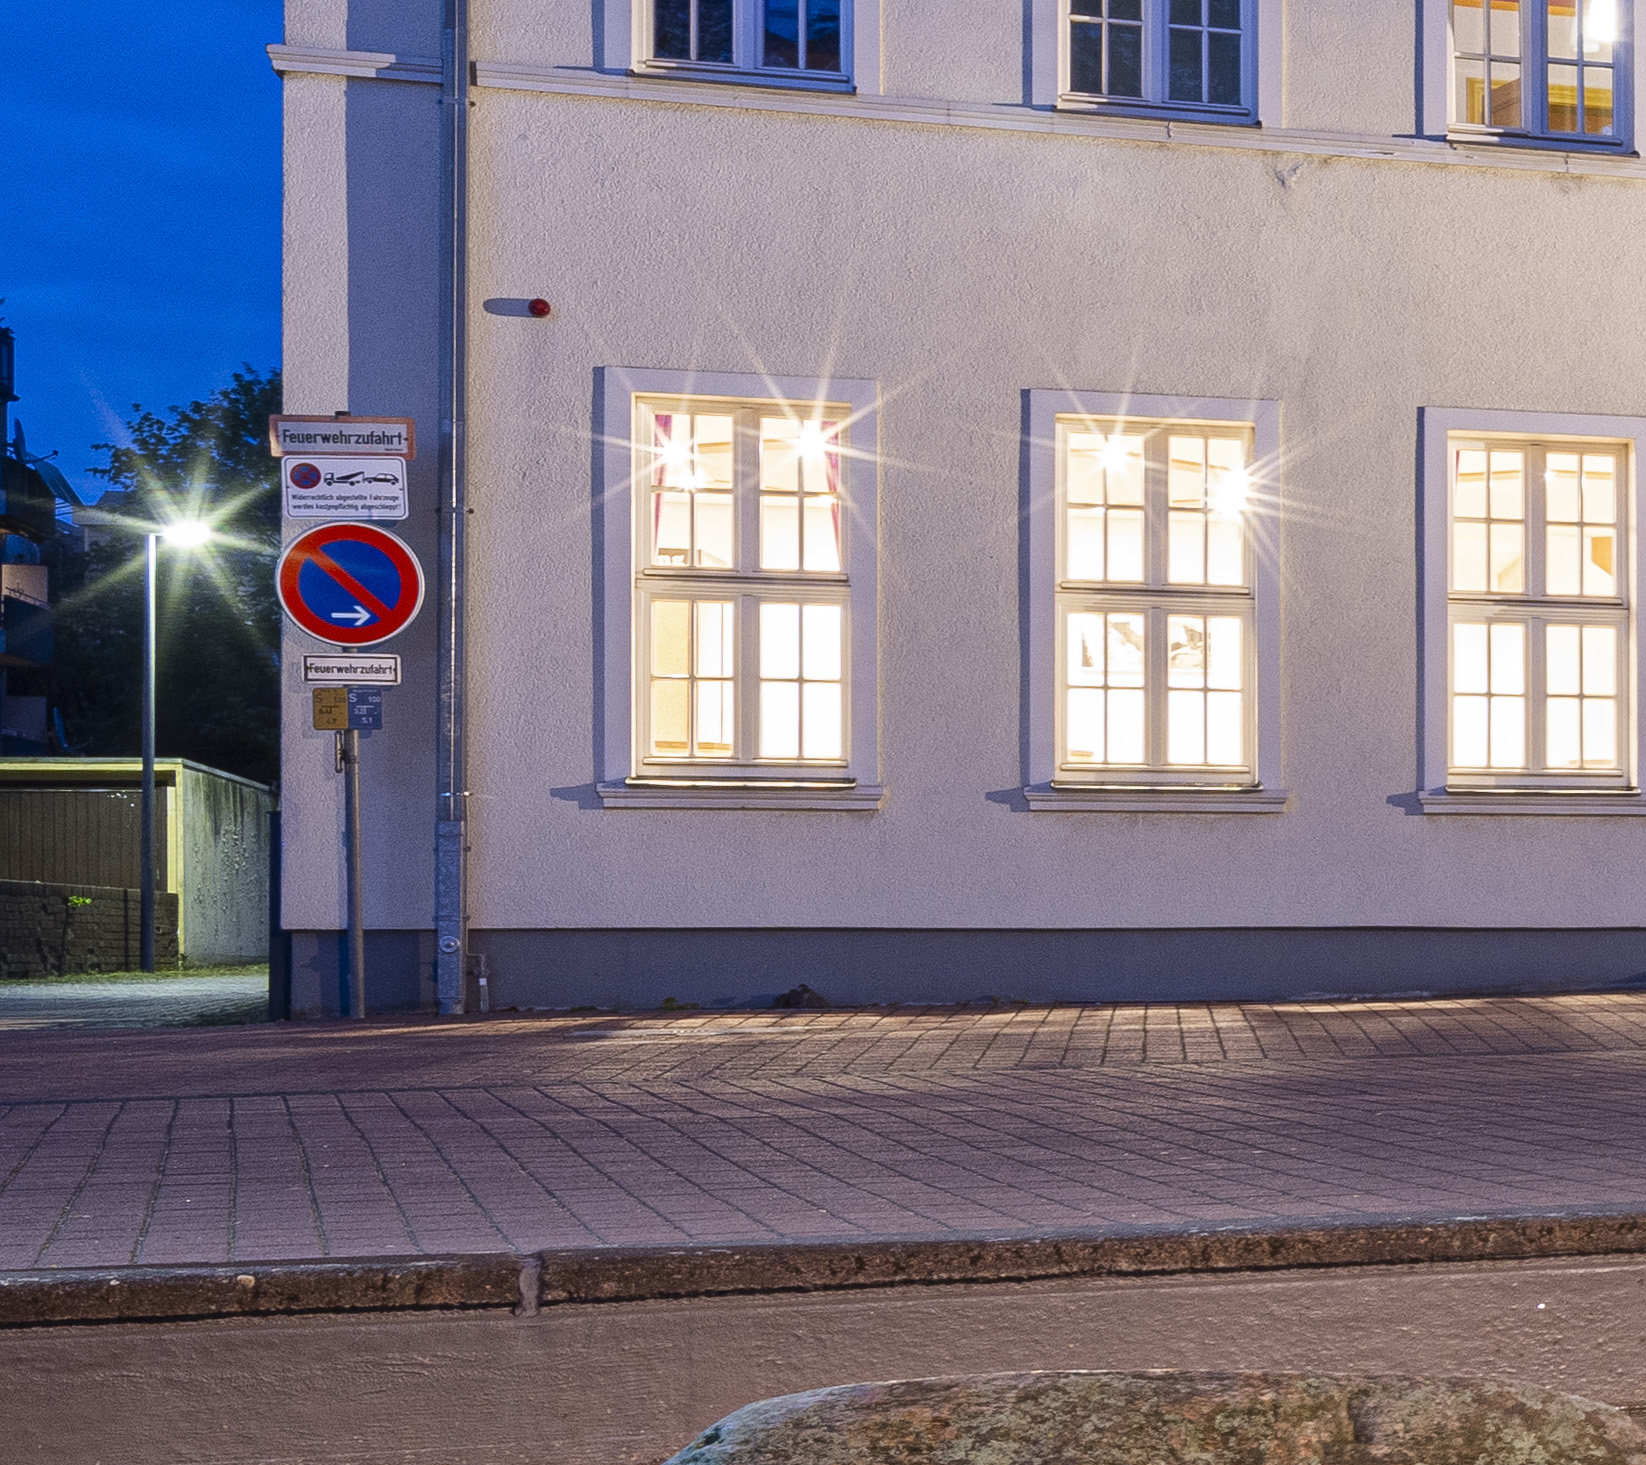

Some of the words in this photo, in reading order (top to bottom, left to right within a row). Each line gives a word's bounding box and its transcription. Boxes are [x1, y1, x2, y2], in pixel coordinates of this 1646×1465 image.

[282, 429, 403, 446] Feuerwehrzufahrt
[369, 494, 399, 502] Fahrzeuge
[308, 662, 393, 675] Feuerwehrzufahrt
[348, 693, 357, 703] S
